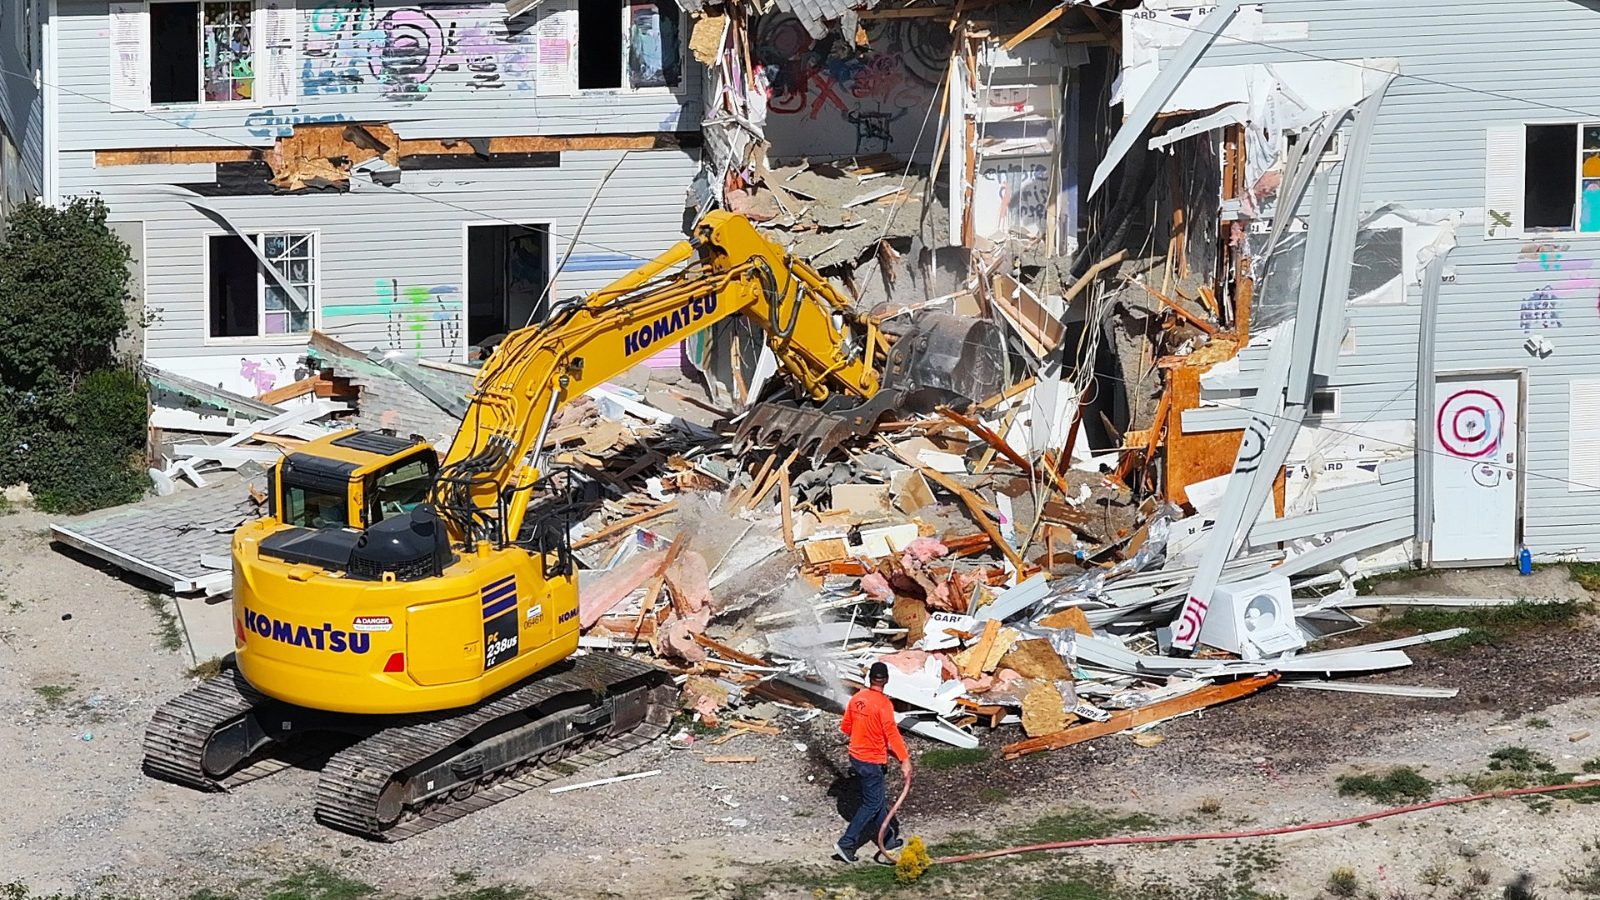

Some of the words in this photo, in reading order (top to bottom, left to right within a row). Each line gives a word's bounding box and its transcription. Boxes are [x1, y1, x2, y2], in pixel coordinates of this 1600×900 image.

[624, 291, 717, 356] KOMATSU
[244, 607, 370, 654] KOMATSU
[487, 631, 499, 645] PC
[487, 656, 496, 667] LC
